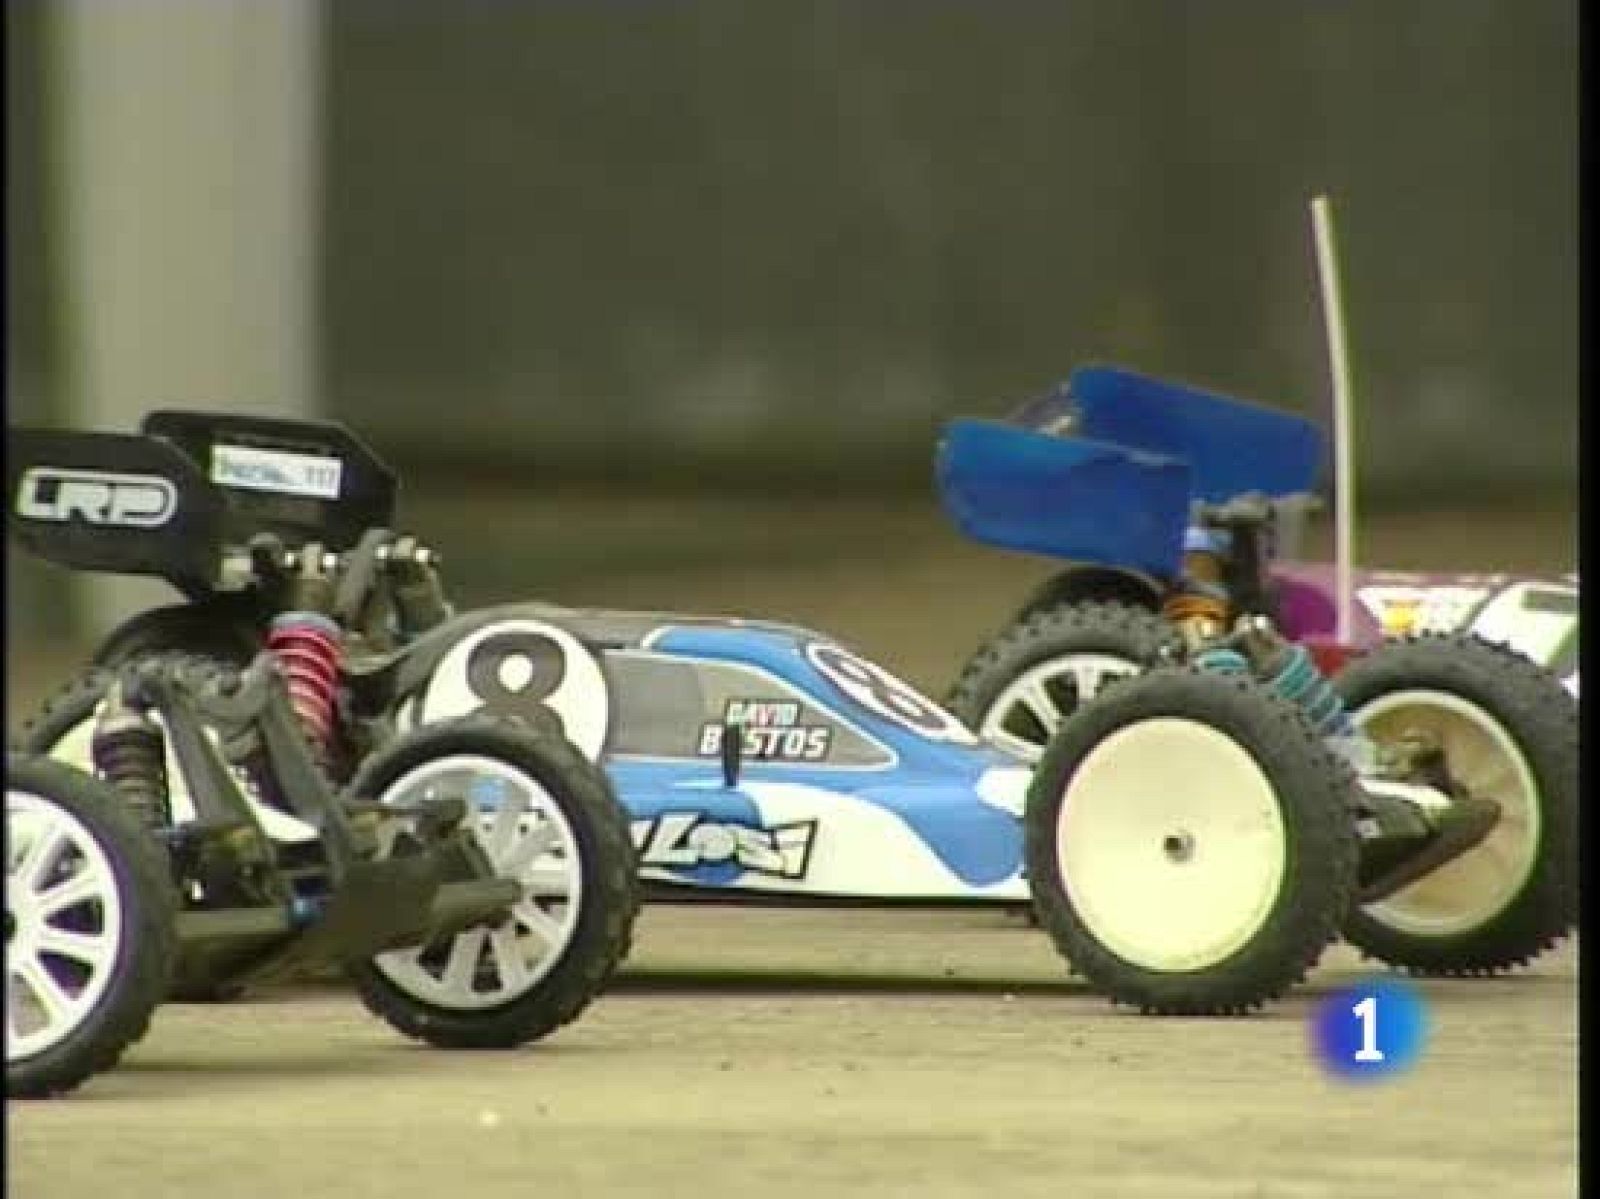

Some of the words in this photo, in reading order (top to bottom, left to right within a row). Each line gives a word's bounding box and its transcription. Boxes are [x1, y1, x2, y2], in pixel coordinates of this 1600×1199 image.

[16, 468, 177, 526] LRP
[466, 632, 568, 738] 8
[700, 723, 829, 758] BSTOS
